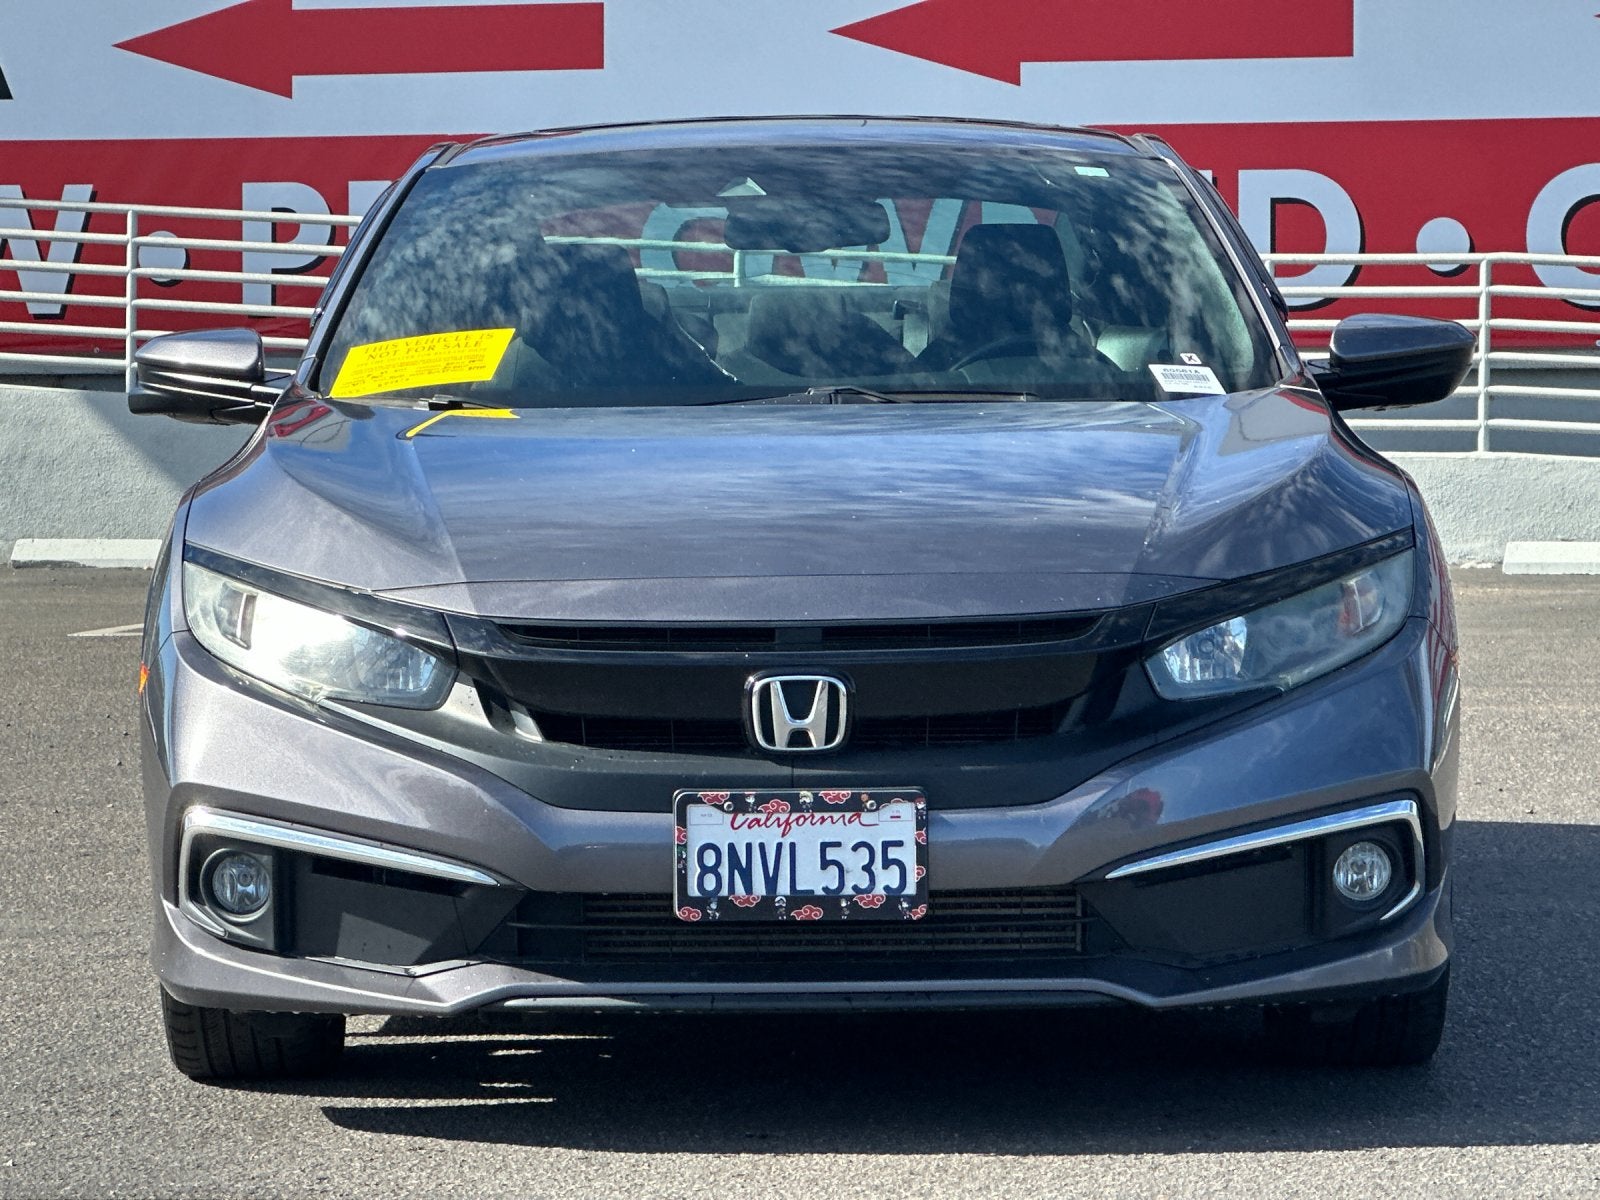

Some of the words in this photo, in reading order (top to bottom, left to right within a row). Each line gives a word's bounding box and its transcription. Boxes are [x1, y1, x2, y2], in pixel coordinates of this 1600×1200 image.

[364, 343, 399, 354] THIS
[405, 333, 470, 347] VEHICLE
[367, 349, 401, 360] NOT
[406, 345, 436, 354] FOR
[443, 340, 482, 351] SALE
[730, 812, 878, 838] California
[696, 840, 907, 896] 8NVL535
